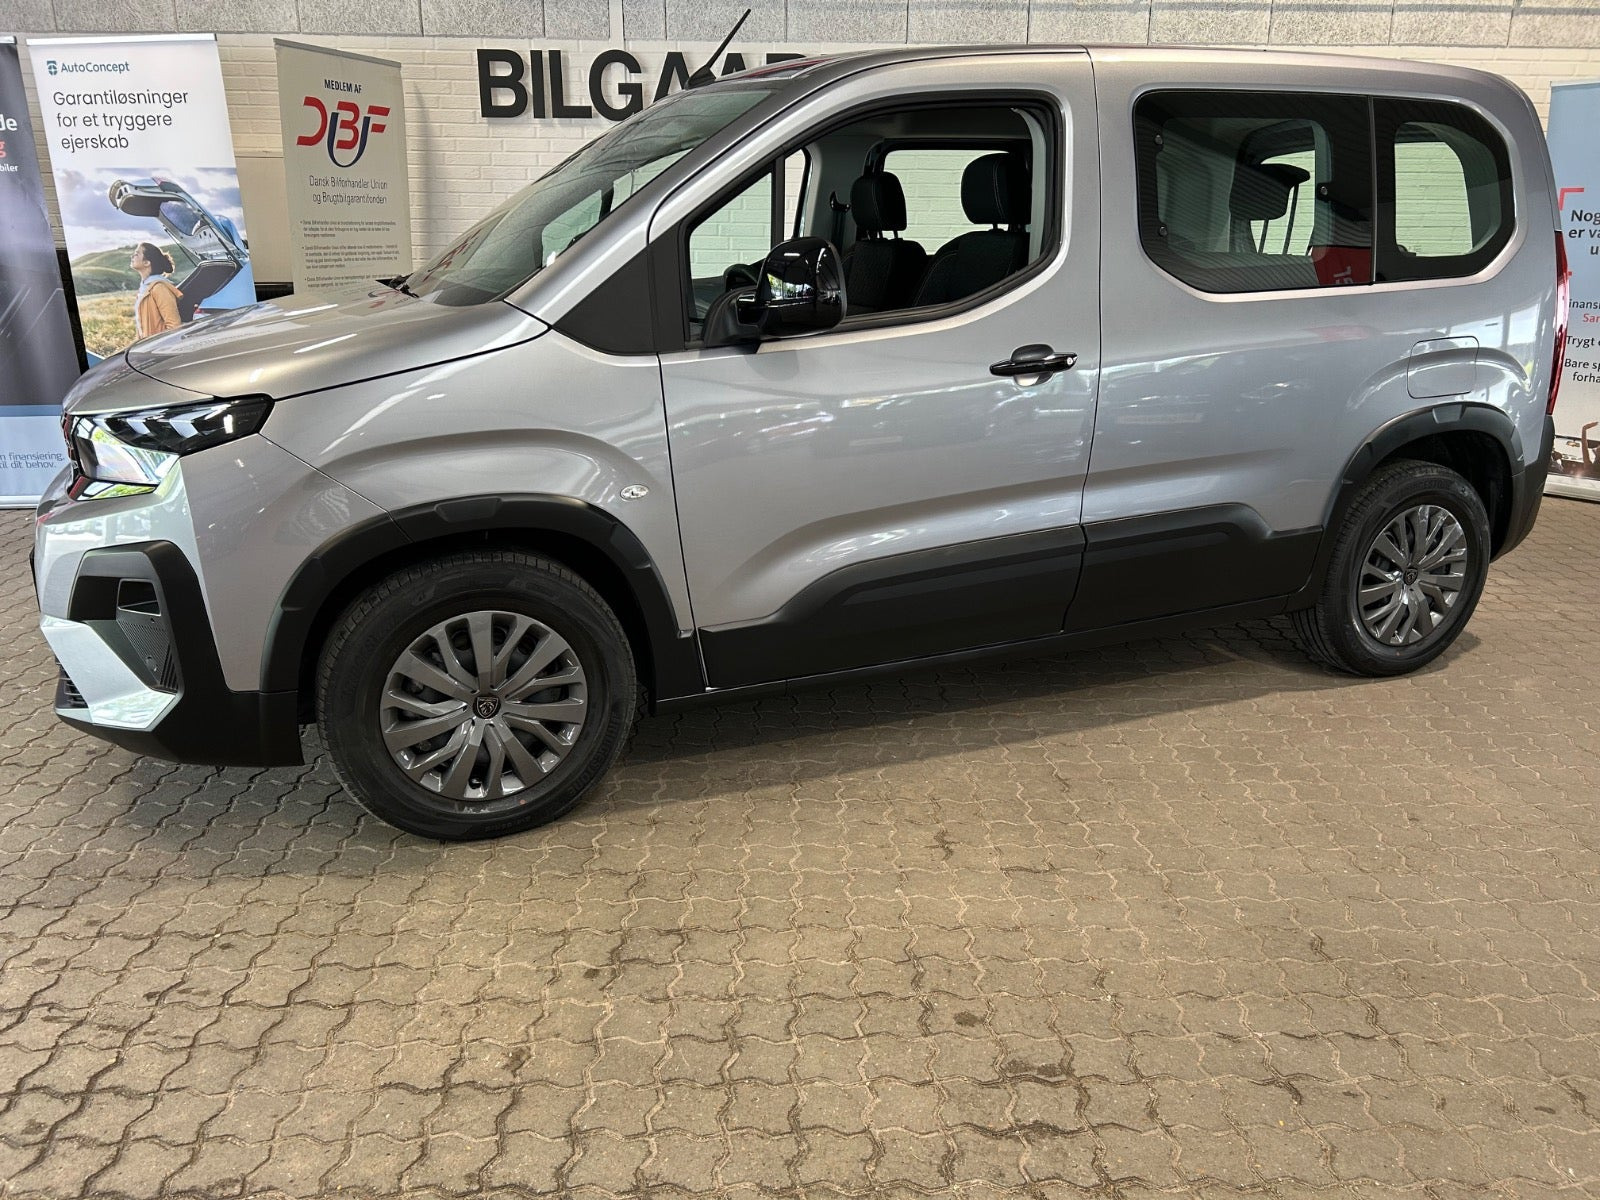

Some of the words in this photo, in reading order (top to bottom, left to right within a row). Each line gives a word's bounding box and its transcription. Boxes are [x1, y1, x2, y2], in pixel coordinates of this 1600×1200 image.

[61, 61, 130, 75] AutoConcept
[324, 79, 353, 92] MEDLEM
[354, 84, 362, 94] AF
[53, 89, 188, 109] Garantiløsninger
[57, 112, 78, 128] for
[82, 113, 99, 128] et
[102, 112, 173, 131] tryggere
[61, 133, 129, 153] ejerskab
[309, 175, 330, 187] Dansk
[312, 193, 321, 205] og
[1568, 229, 1585, 239] er
[1566, 335, 1595, 349] Trygt
[1564, 358, 1590, 369] Bare
